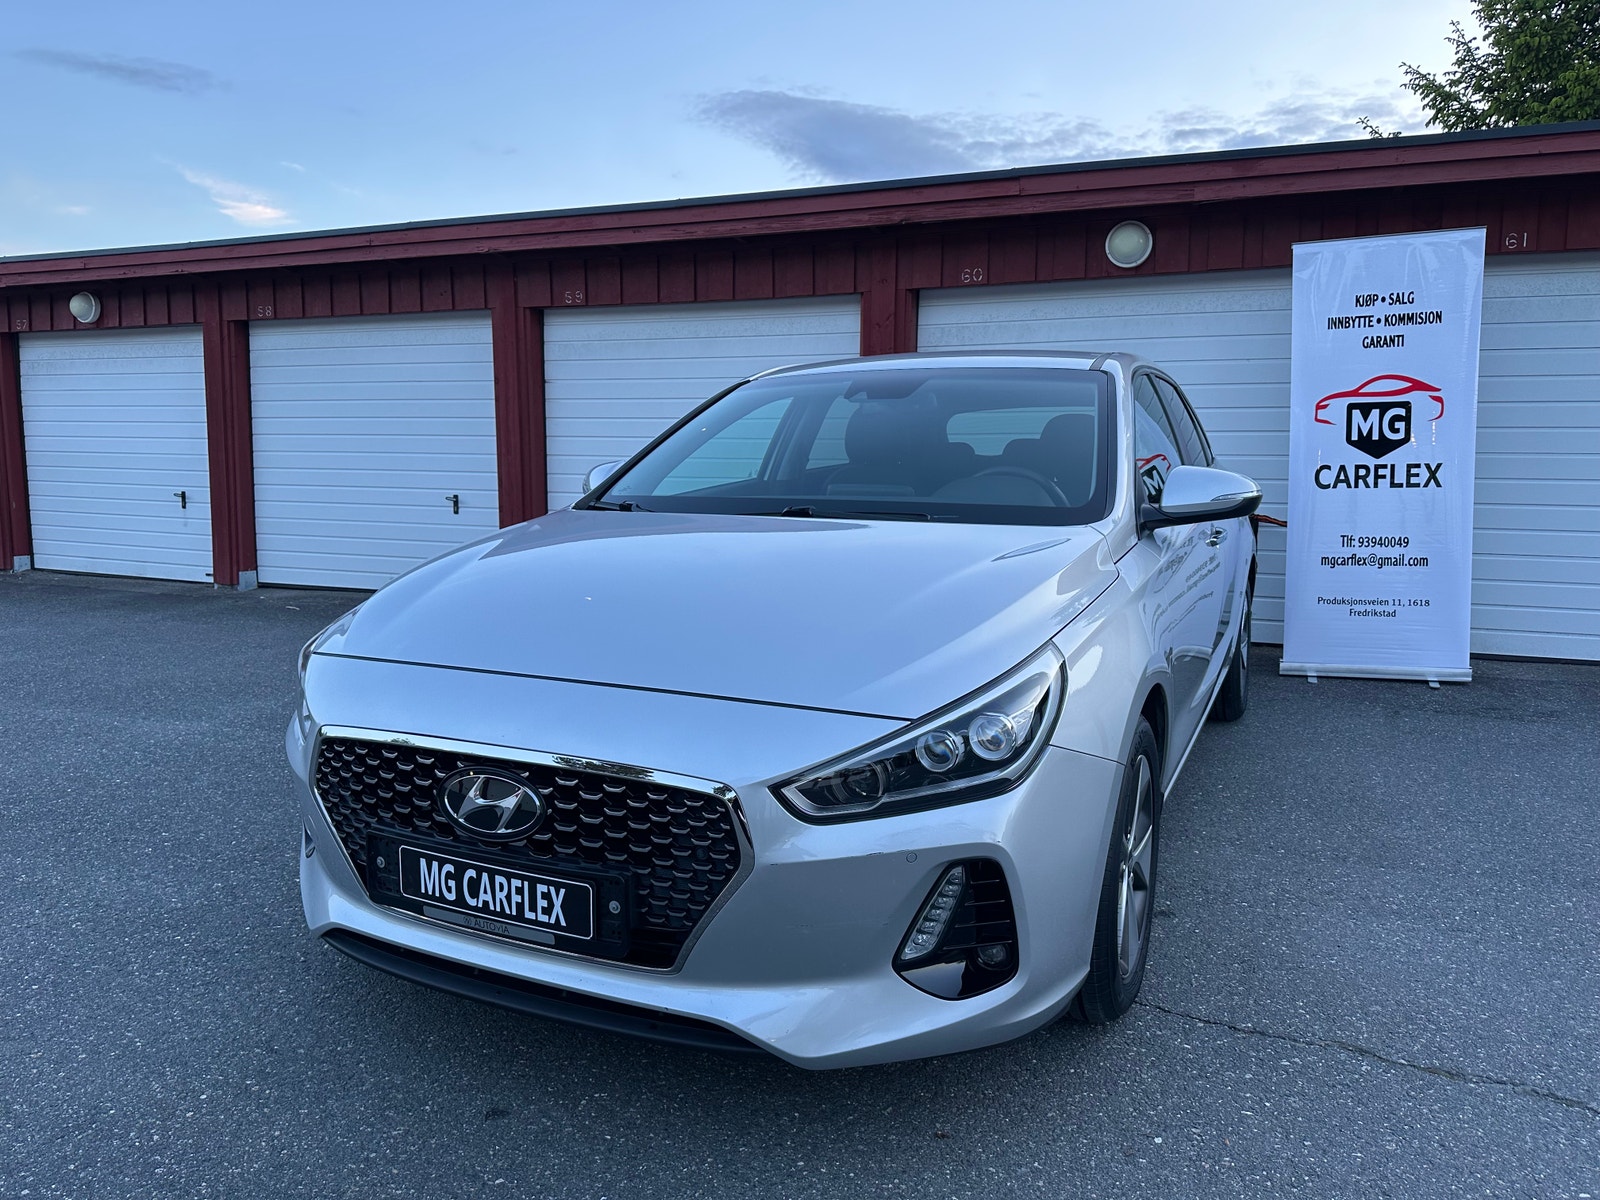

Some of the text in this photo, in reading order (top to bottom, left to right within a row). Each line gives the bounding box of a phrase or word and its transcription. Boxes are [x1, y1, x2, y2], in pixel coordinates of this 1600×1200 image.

[1505, 232, 1528, 249] 61
[961, 267, 983, 283] 60
[564, 290, 583, 304] 59
[1354, 290, 1415, 308] KJØP SALG
[257, 305, 272, 318] 58
[1327, 310, 1443, 330] INNBYTTE KOMMISJON
[1361, 334, 1405, 349] GARANTI
[1350, 407, 1407, 441] MG
[1314, 462, 1444, 490] CARFLEX
[1339, 534, 1410, 549] Tlf: 93940049
[1320, 553, 1429, 570] mgcarflex@gmail.com
[1317, 596, 1390, 608] Produksjonsveien
[1407, 598, 1431, 608] 1618
[1349, 608, 1397, 618] Fredrikstad
[419, 857, 567, 927] MG CARFLEX
